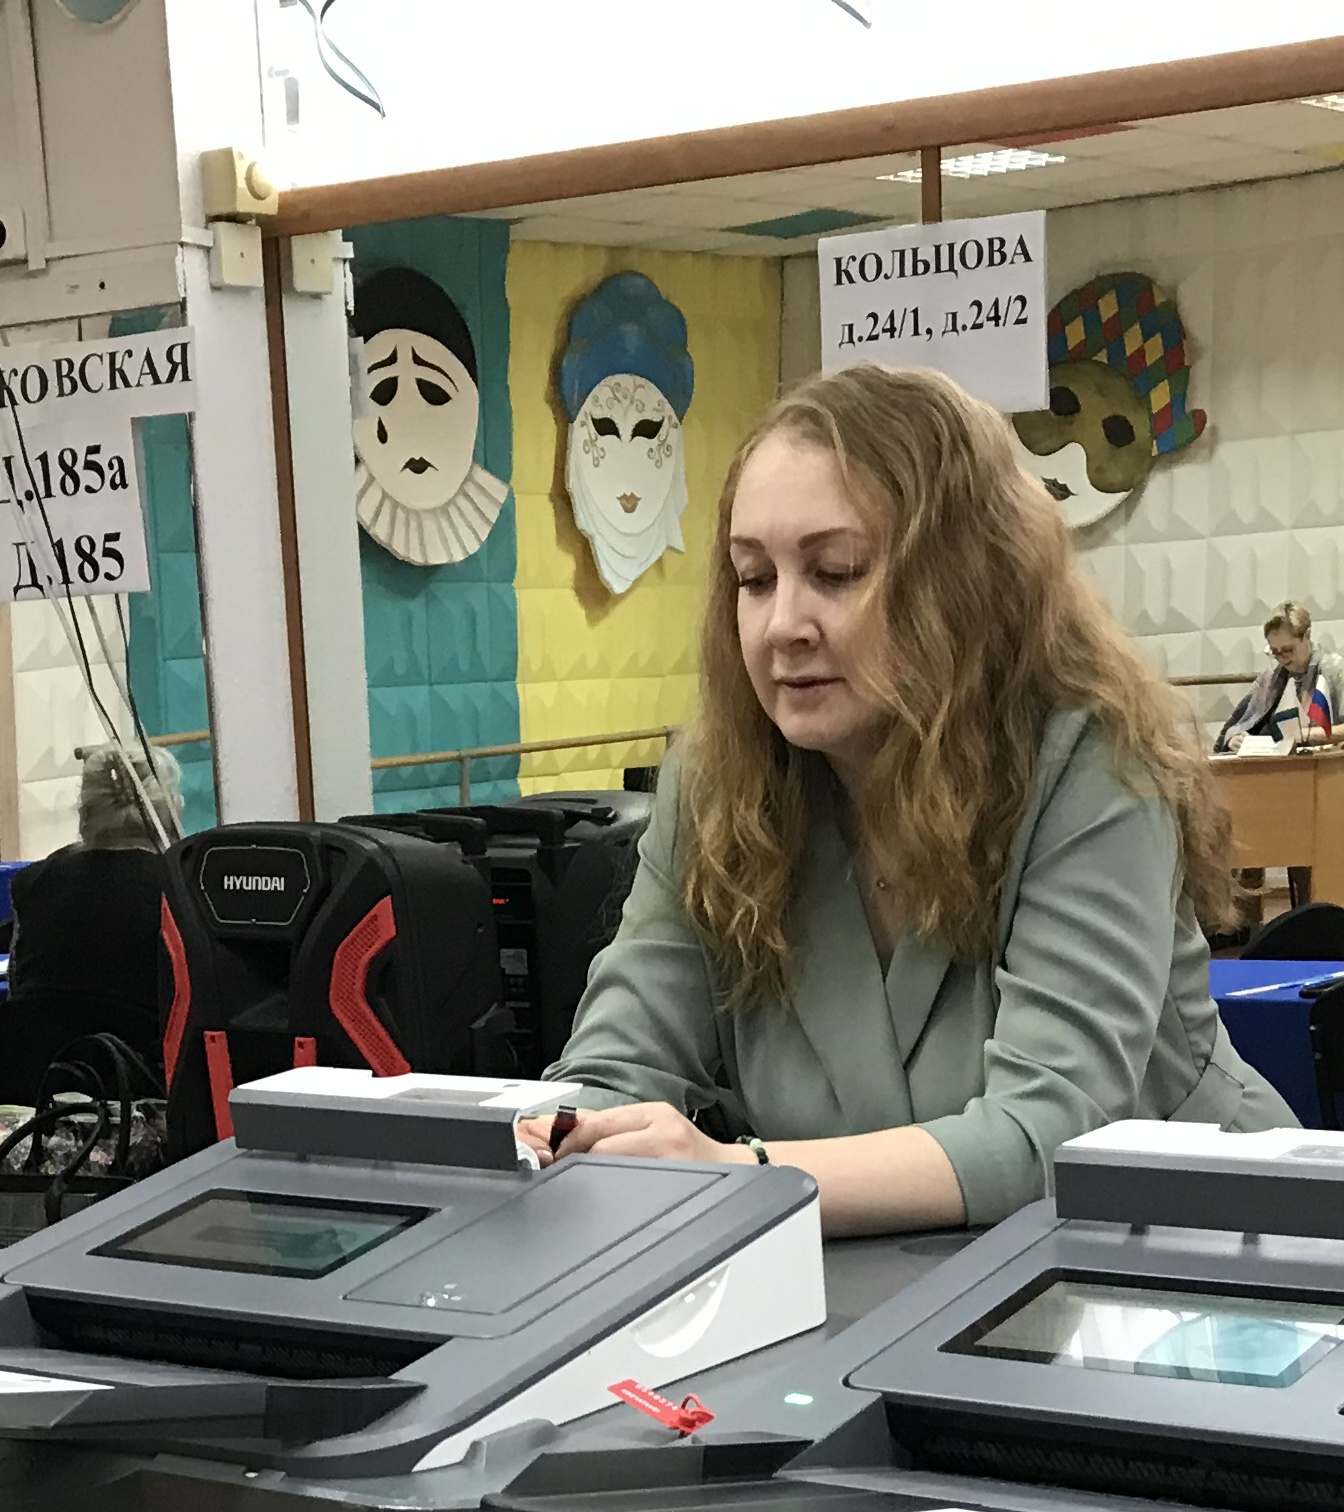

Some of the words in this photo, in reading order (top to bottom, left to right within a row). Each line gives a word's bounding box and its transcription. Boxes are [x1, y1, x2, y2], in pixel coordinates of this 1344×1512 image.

[833, 233, 1033, 287] КОЛЬЦОВА
[838, 306, 933, 349] д.24/1,
[941, 294, 1029, 338] д.24/2
[12, 532, 125, 600] Д.185
[223, 875, 285, 891] HYUNDAI
